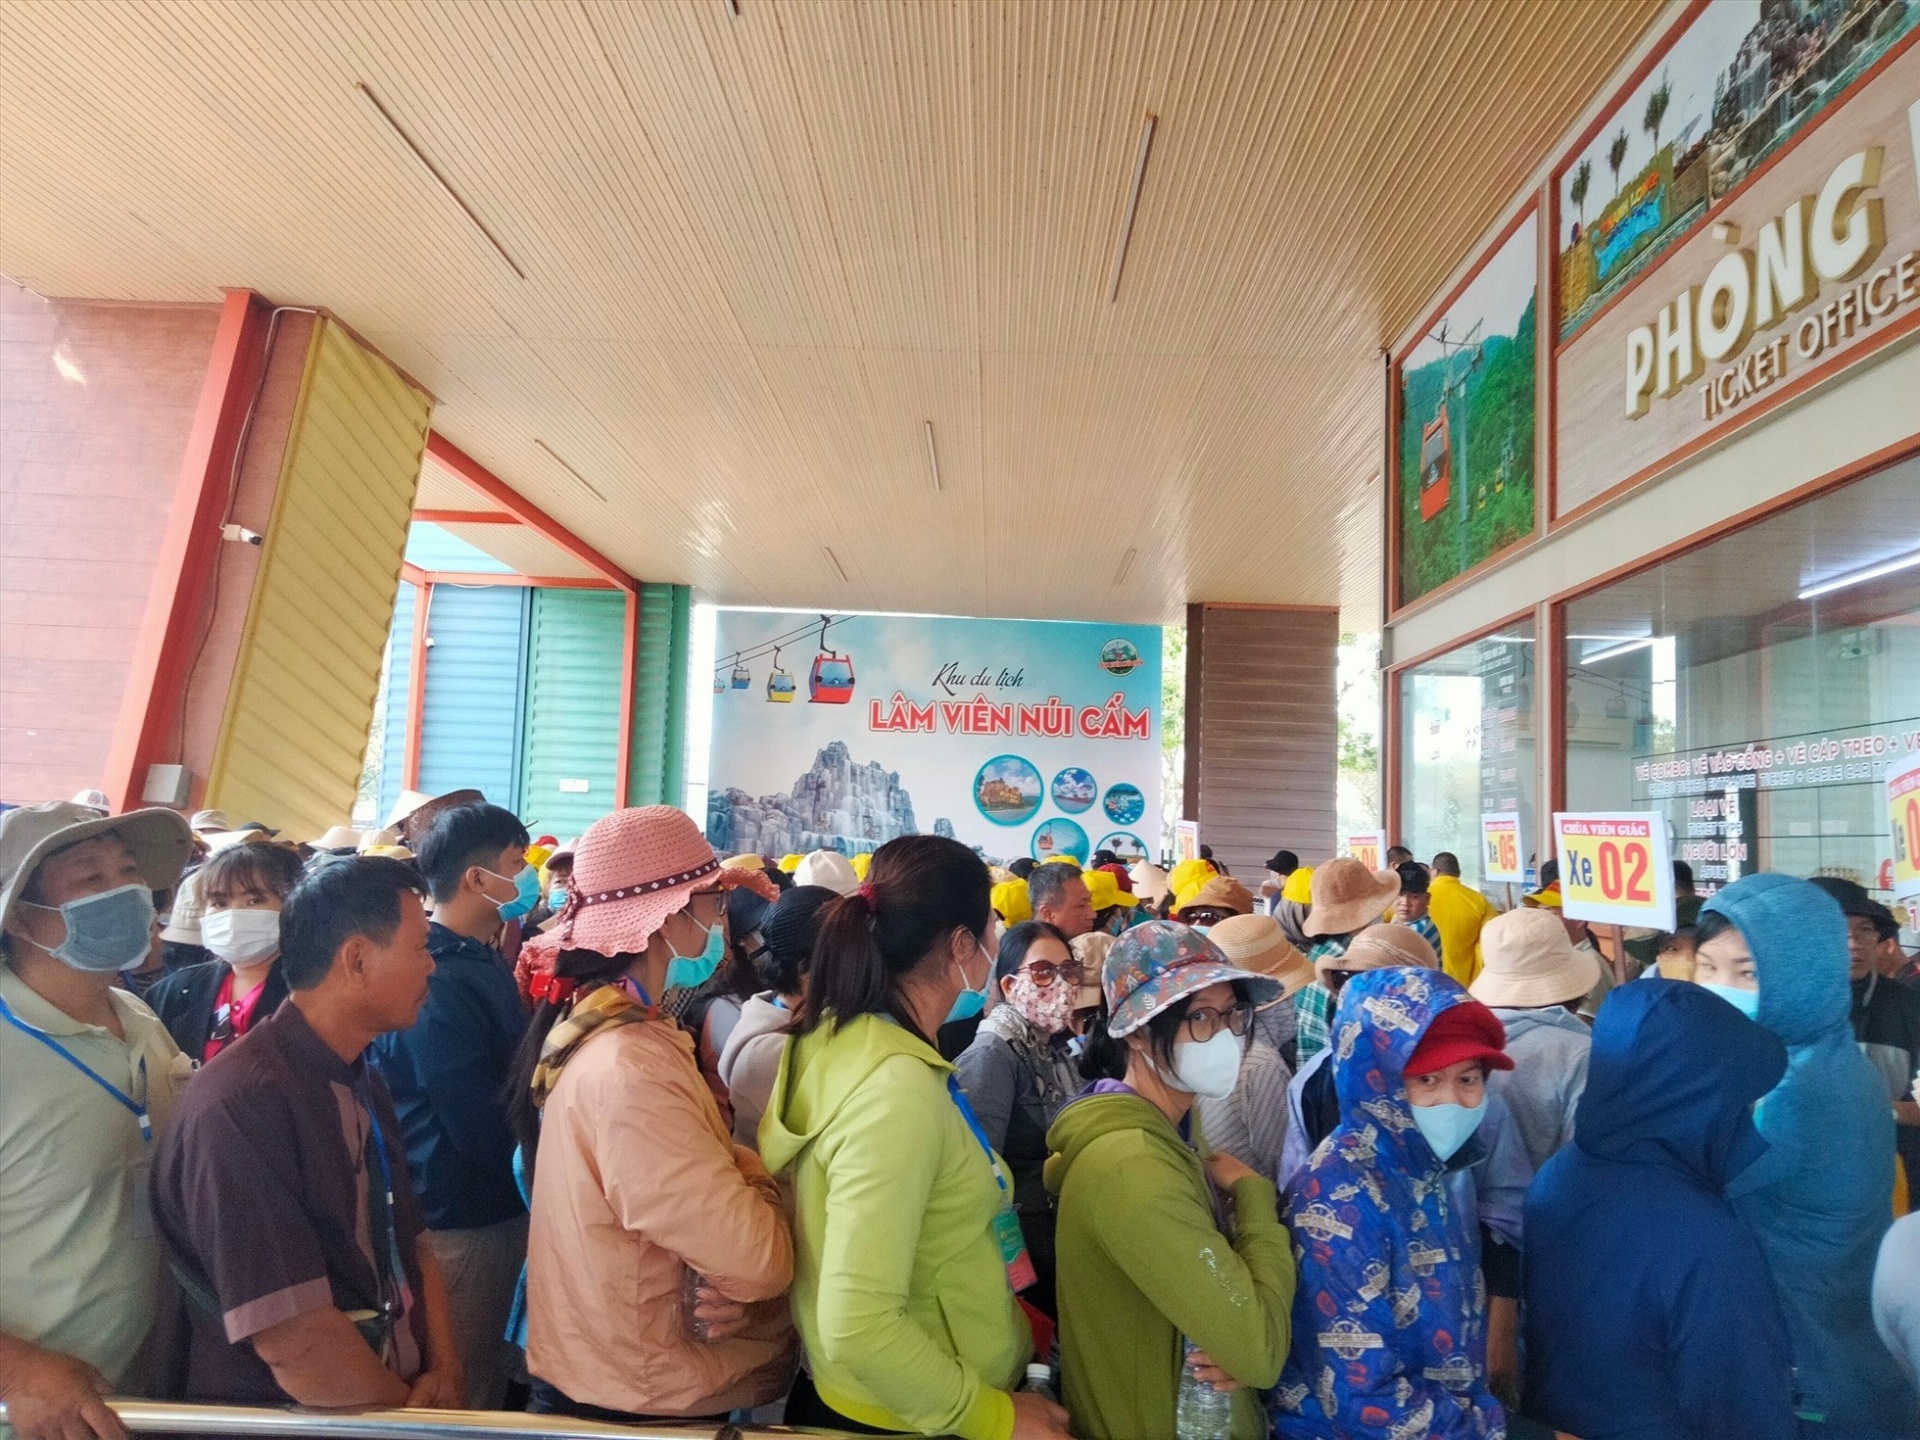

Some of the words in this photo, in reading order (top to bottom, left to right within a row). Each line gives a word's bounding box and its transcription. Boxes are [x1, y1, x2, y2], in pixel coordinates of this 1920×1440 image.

[1625, 147, 1884, 417] PHÒNG
[1699, 336, 1789, 420] TICKET
[1797, 251, 1920, 360] OFFICE
[931, 661, 967, 696] Khu
[970, 667, 992, 686] du
[995, 667, 1025, 691] lịch
[869, 691, 938, 733] LÂM
[941, 693, 1014, 736] VIÊN
[1018, 696, 1074, 737] NÚI
[1078, 691, 1151, 740] CẤM
[1841, 735, 1885, 759] TREO
[1499, 834, 1517, 871] 05
[1563, 821, 1589, 835] CHÙA
[1589, 821, 1616, 836] VIÊN
[1617, 822, 1648, 836] GIÁC
[1906, 798, 1920, 871] 0
[1567, 849, 1593, 888] Xe
[1598, 841, 1651, 902] 02
